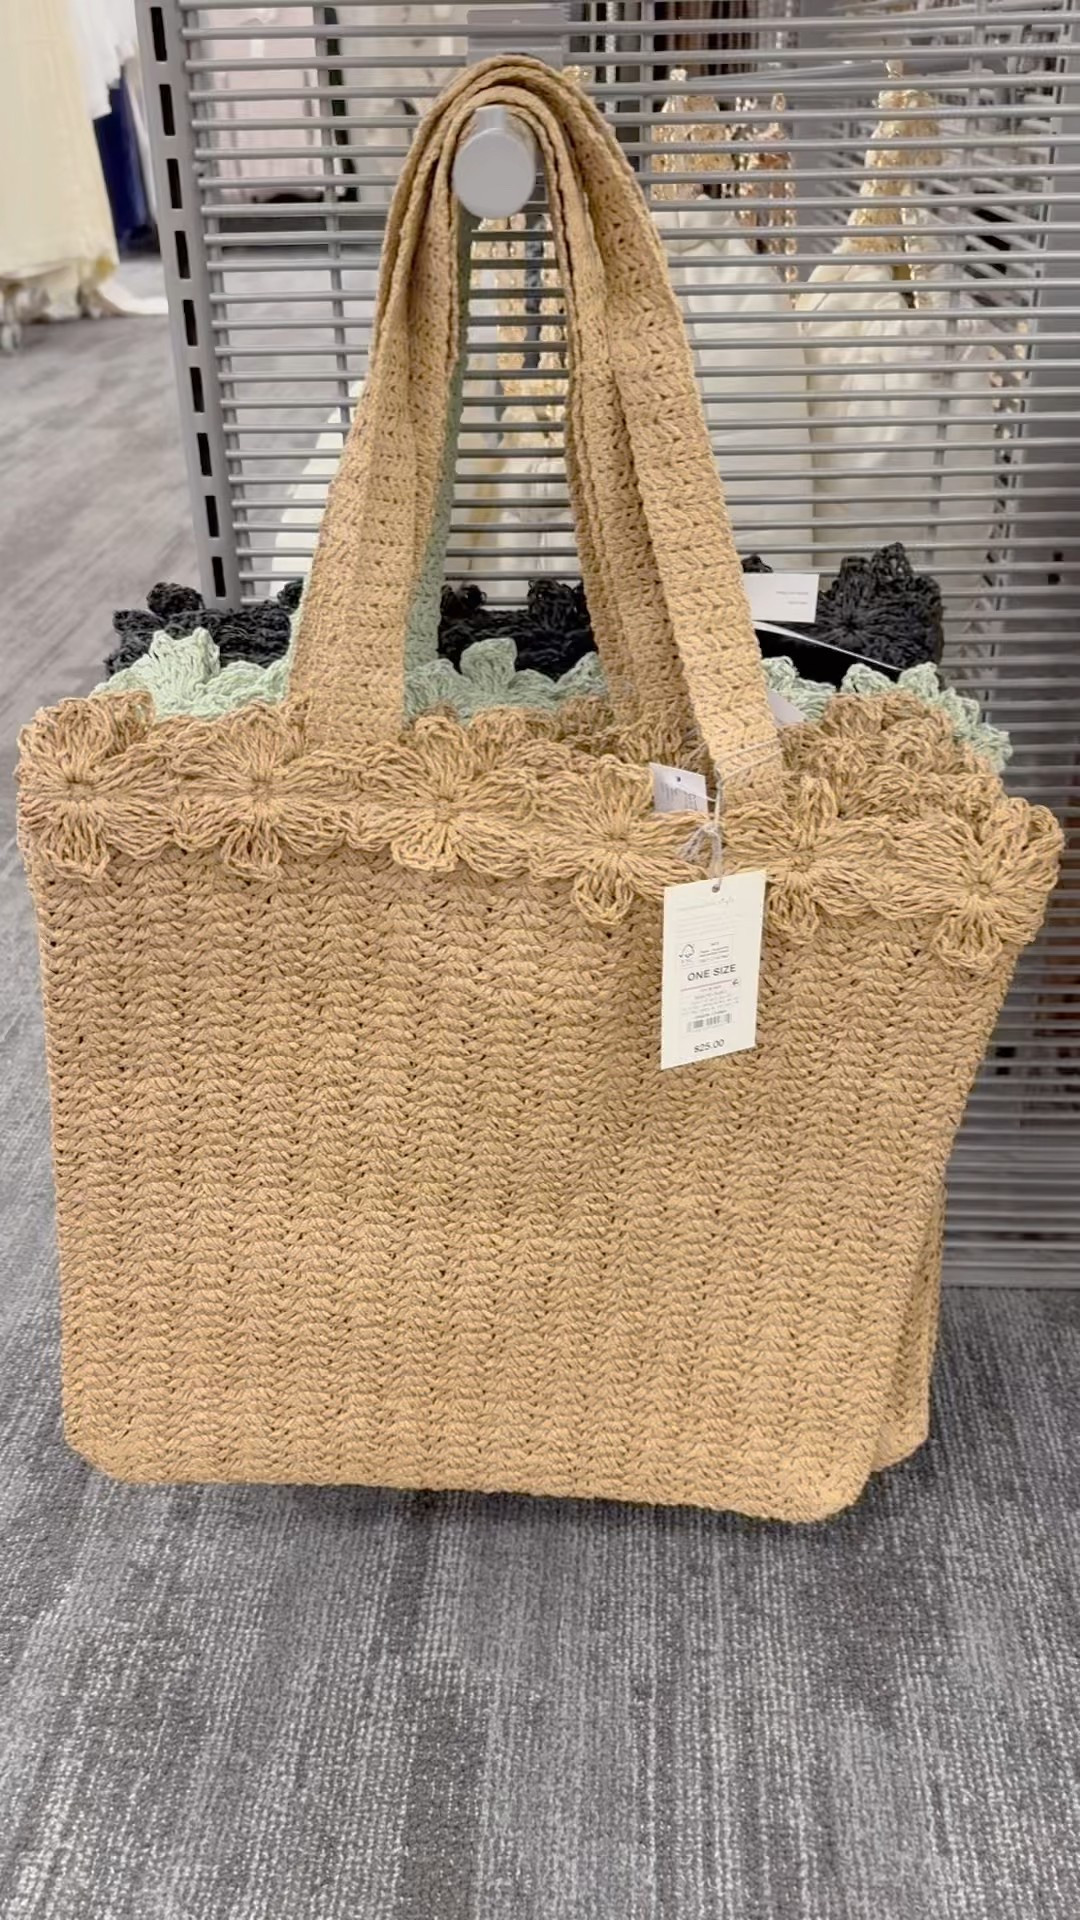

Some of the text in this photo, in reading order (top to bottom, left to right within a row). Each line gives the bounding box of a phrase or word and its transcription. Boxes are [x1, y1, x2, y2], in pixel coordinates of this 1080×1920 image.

[687, 963, 737, 982] ONE SIZE
[694, 1038, 725, 1053] $25.00
